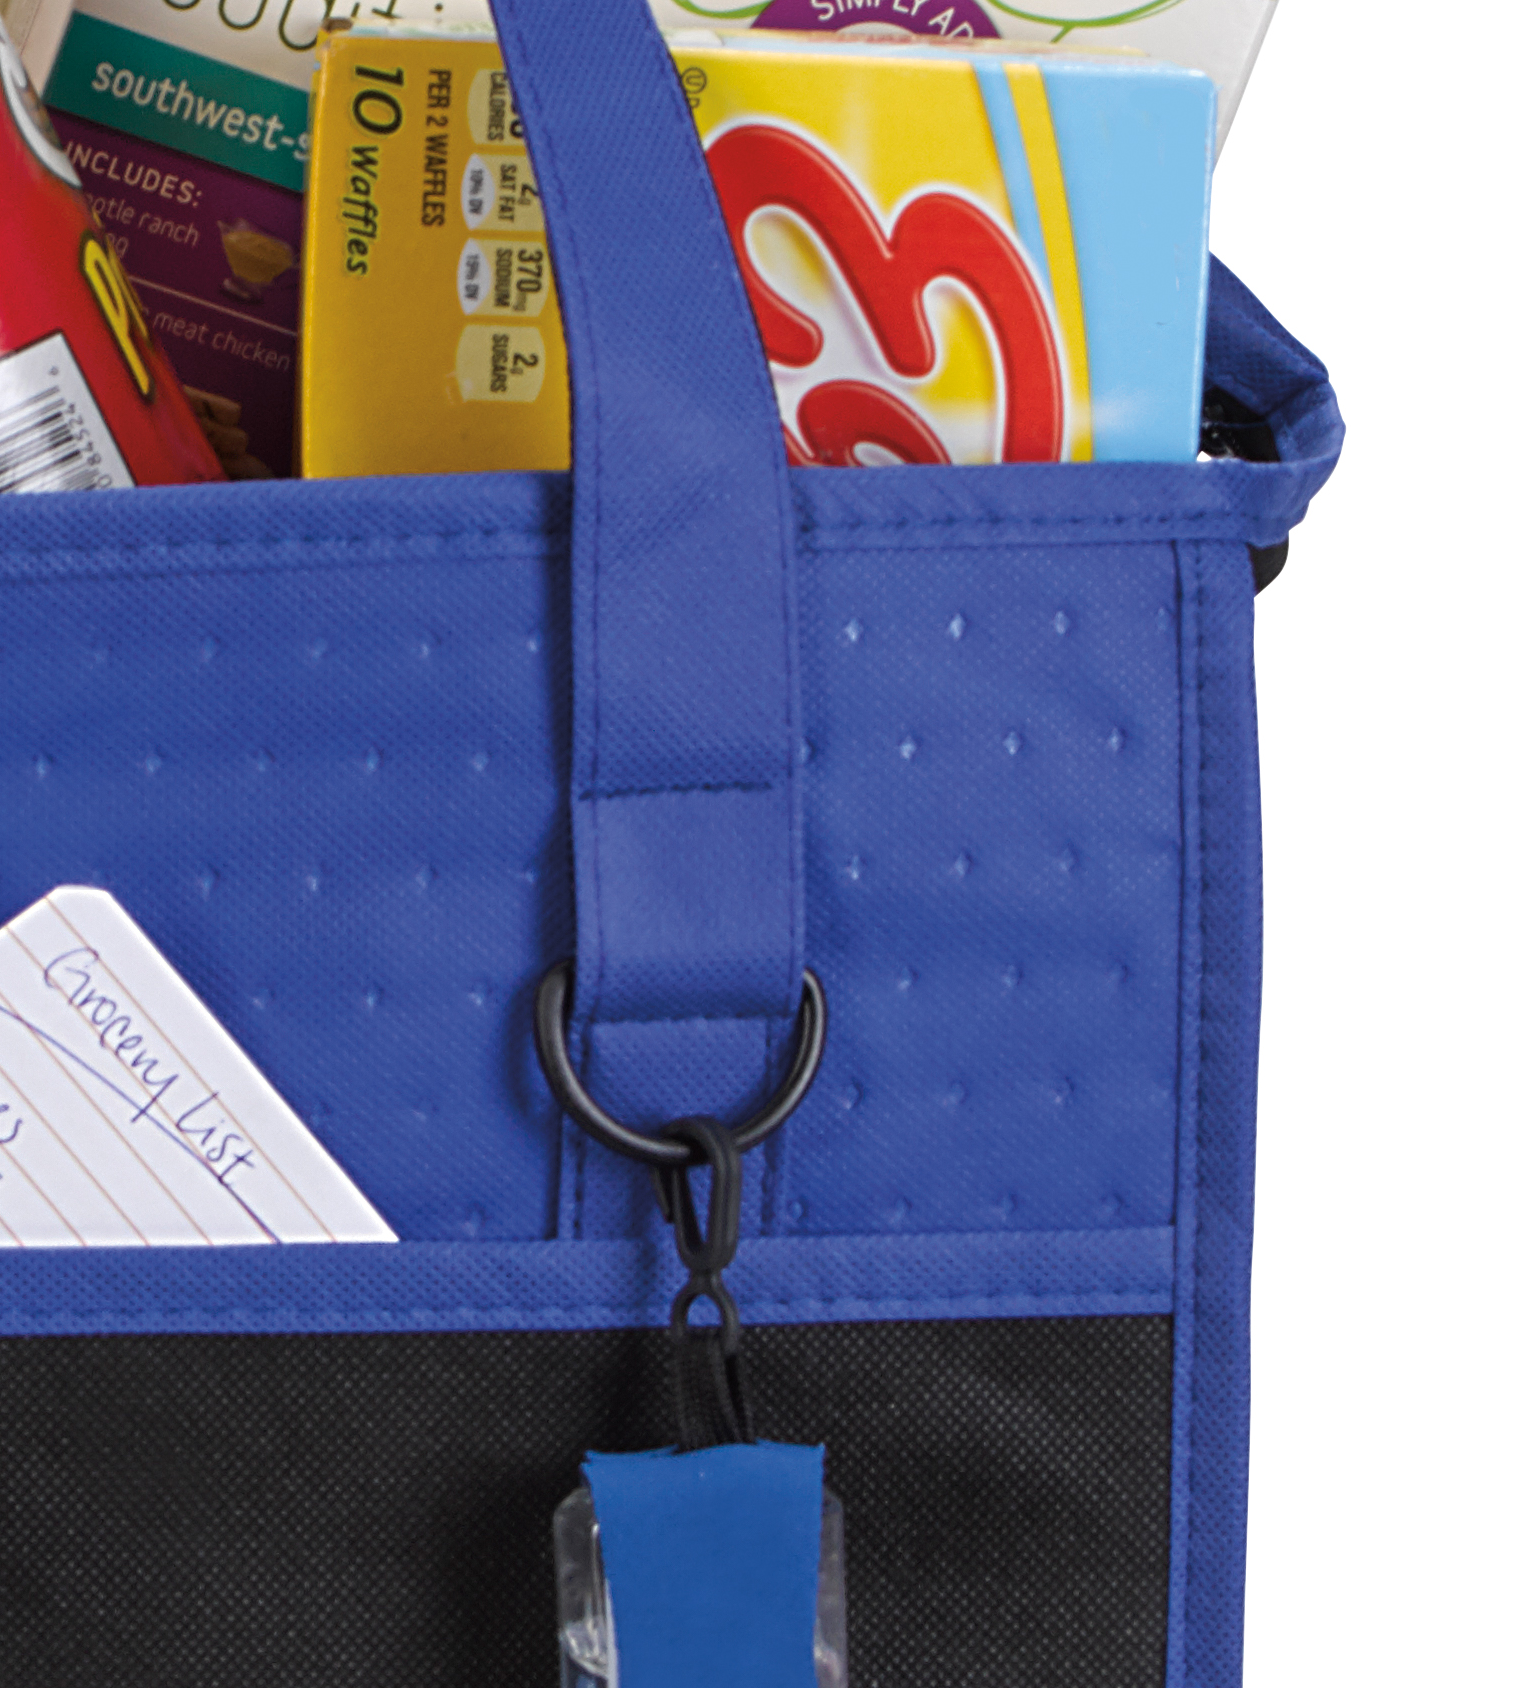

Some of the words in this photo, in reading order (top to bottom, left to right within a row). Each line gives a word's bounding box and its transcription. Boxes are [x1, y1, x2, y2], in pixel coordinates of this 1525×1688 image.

[352, 65, 405, 135] 10
[427, 68, 452, 109] PER
[487, 71, 508, 142] CALORIES
[426, 114, 449, 128] 2
[421, 134, 449, 228] WAFFLES
[498, 194, 515, 223] FAT
[499, 163, 516, 193] SAT
[138, 209, 200, 248] ranch
[494, 248, 513, 309] SODIUM
[153, 310, 210, 345] meat
[211, 330, 291, 371] chicken
[490, 333, 510, 394] SUGARS
[44, 948, 179, 1123] Grocery
